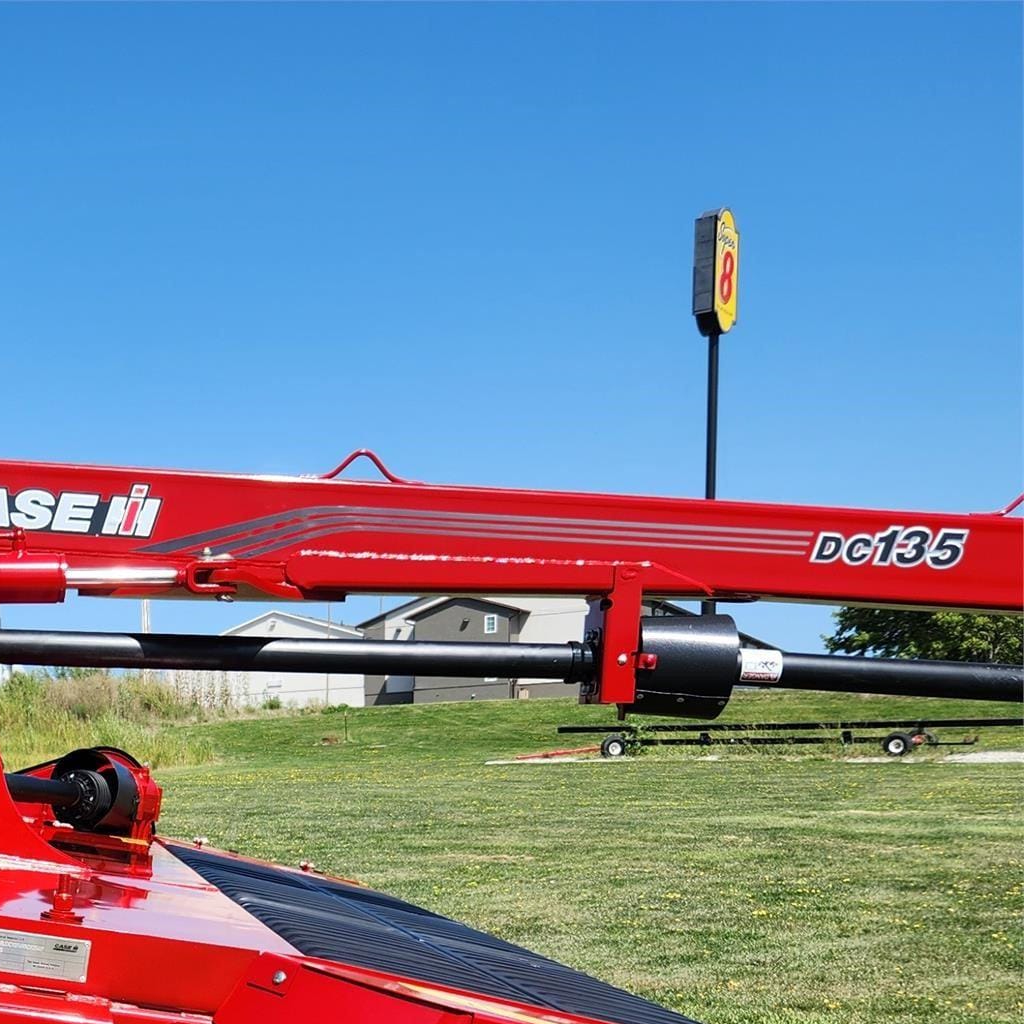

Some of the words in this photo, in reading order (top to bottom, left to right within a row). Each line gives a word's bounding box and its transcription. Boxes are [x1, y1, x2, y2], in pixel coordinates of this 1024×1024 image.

[717, 221, 736, 255] Super
[719, 251, 735, 305] 8
[809, 525, 970, 570] DC135
